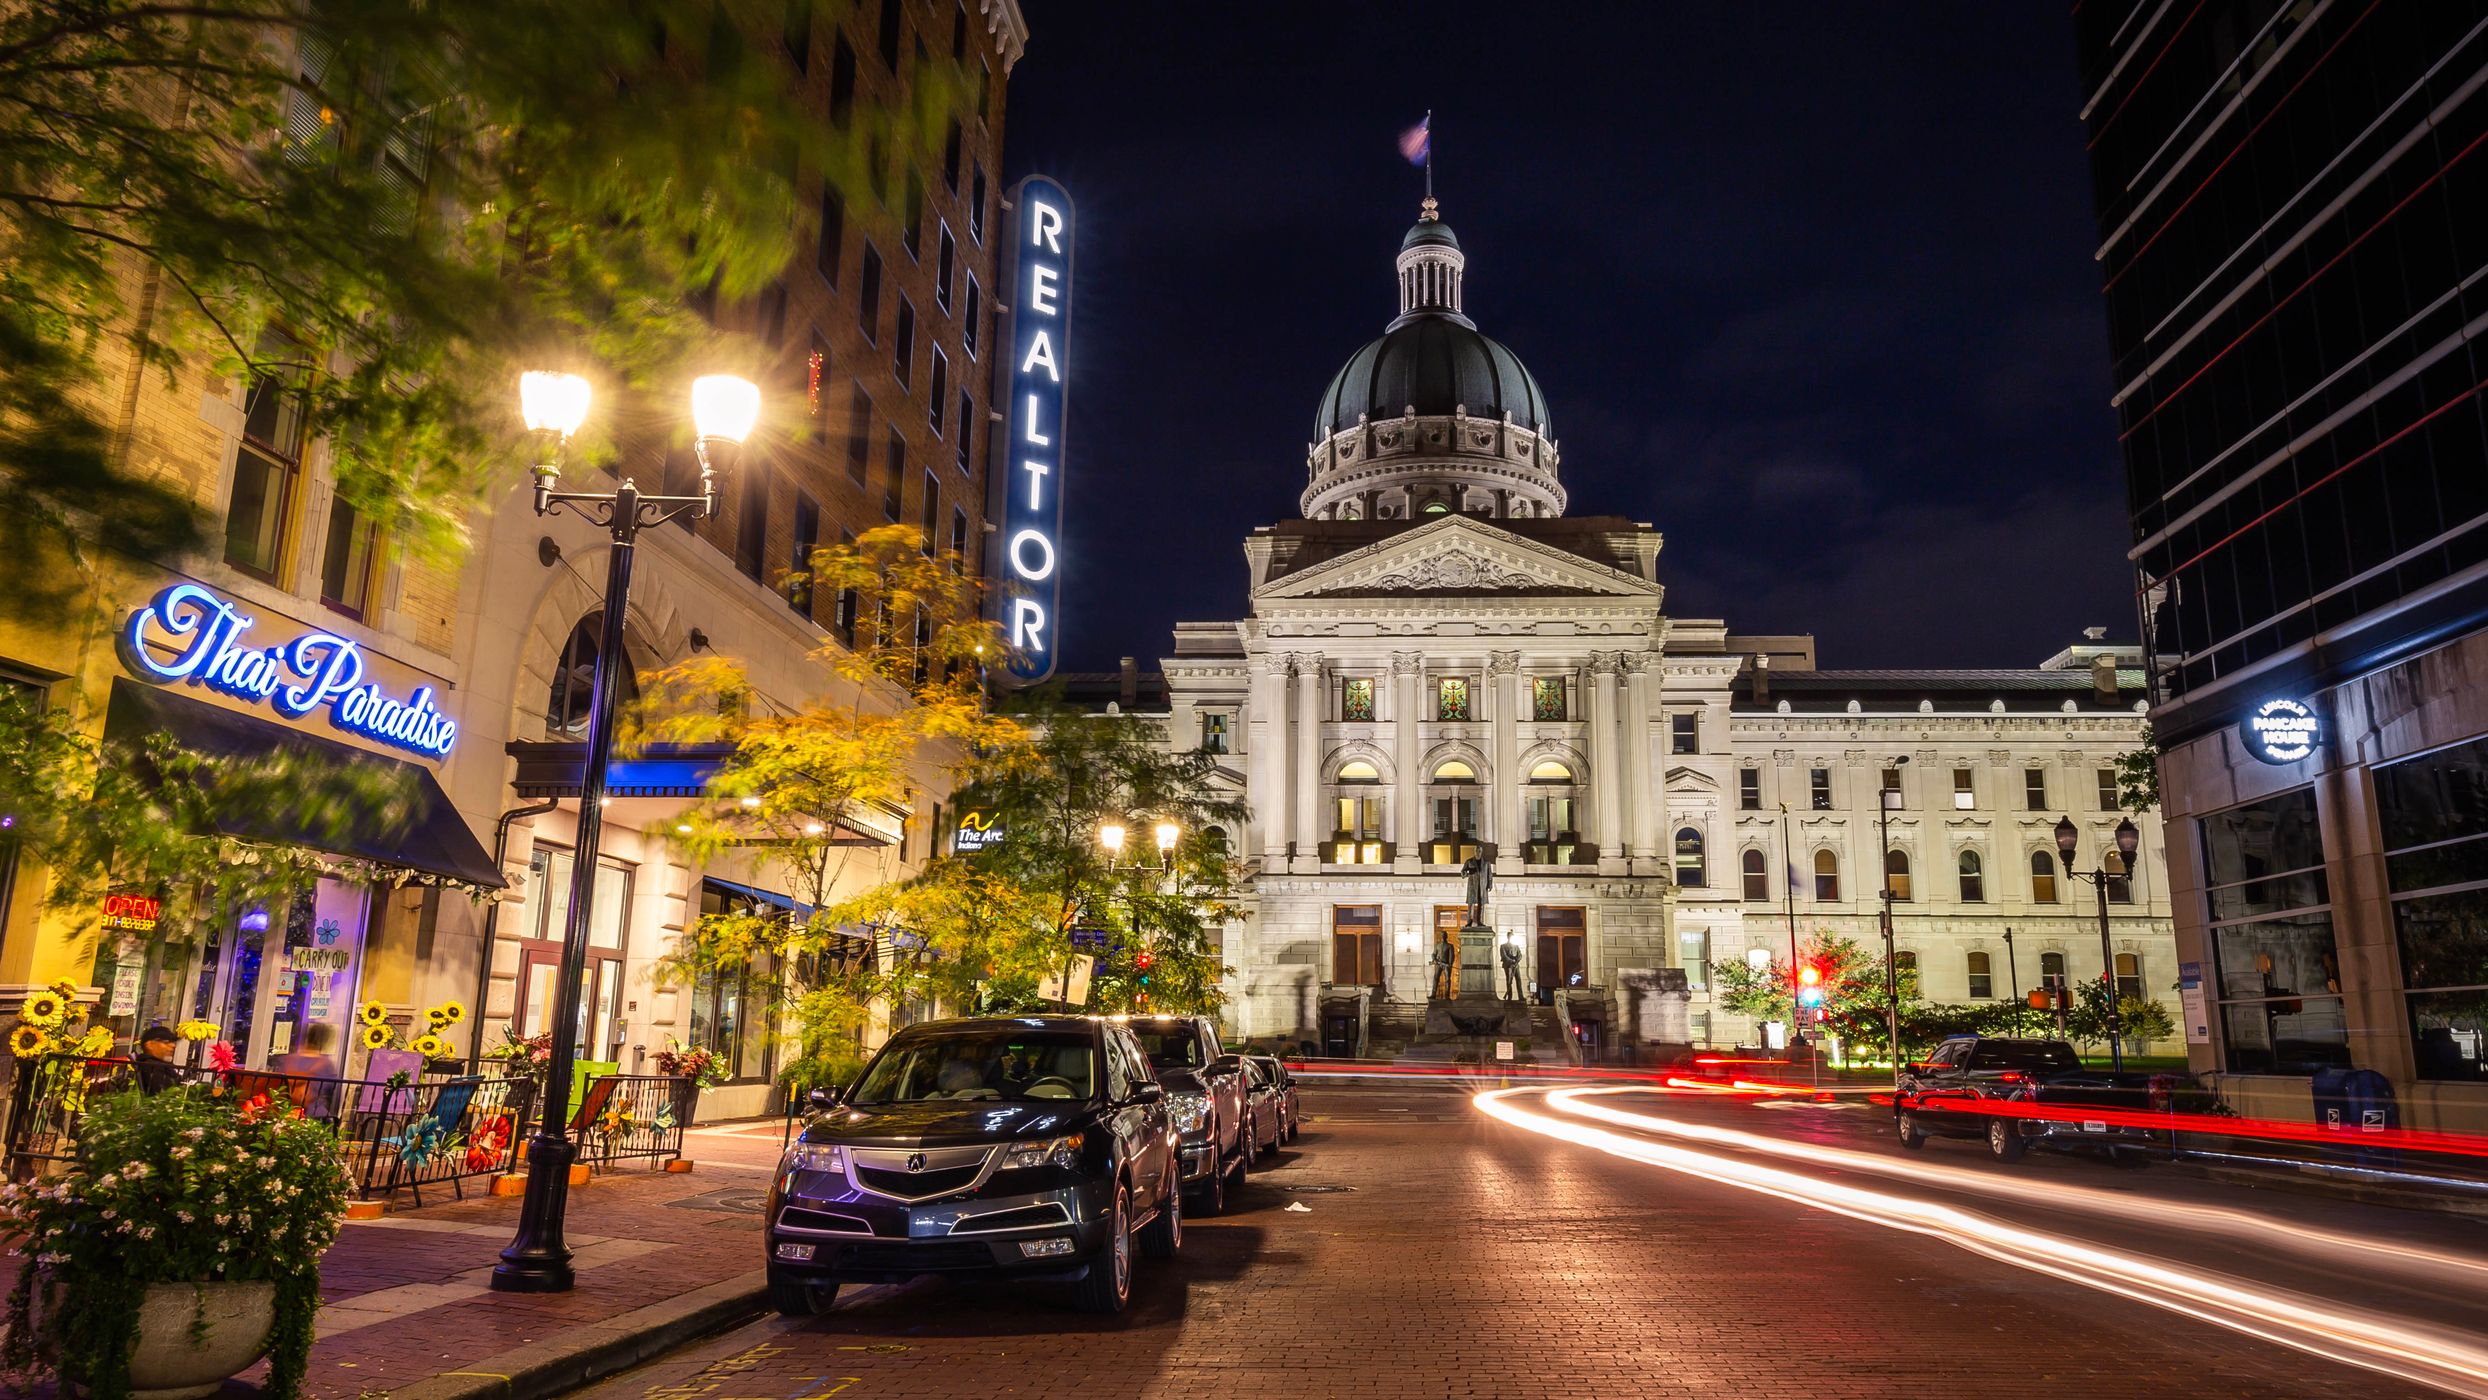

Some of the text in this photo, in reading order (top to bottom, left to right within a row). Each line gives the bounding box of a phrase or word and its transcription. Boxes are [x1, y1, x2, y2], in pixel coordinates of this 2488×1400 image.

[1010, 200, 1064, 652] REALTOR
[128, 583, 458, 755] Thai Paradise
[2253, 717, 2317, 731] PANCAKE
[2263, 731, 2310, 744] HOUSE
[959, 829, 981, 841] The
[957, 841, 982, 849] Indiana
[106, 896, 158, 919] OPEN
[298, 950, 349, 970] CARRY OUT
